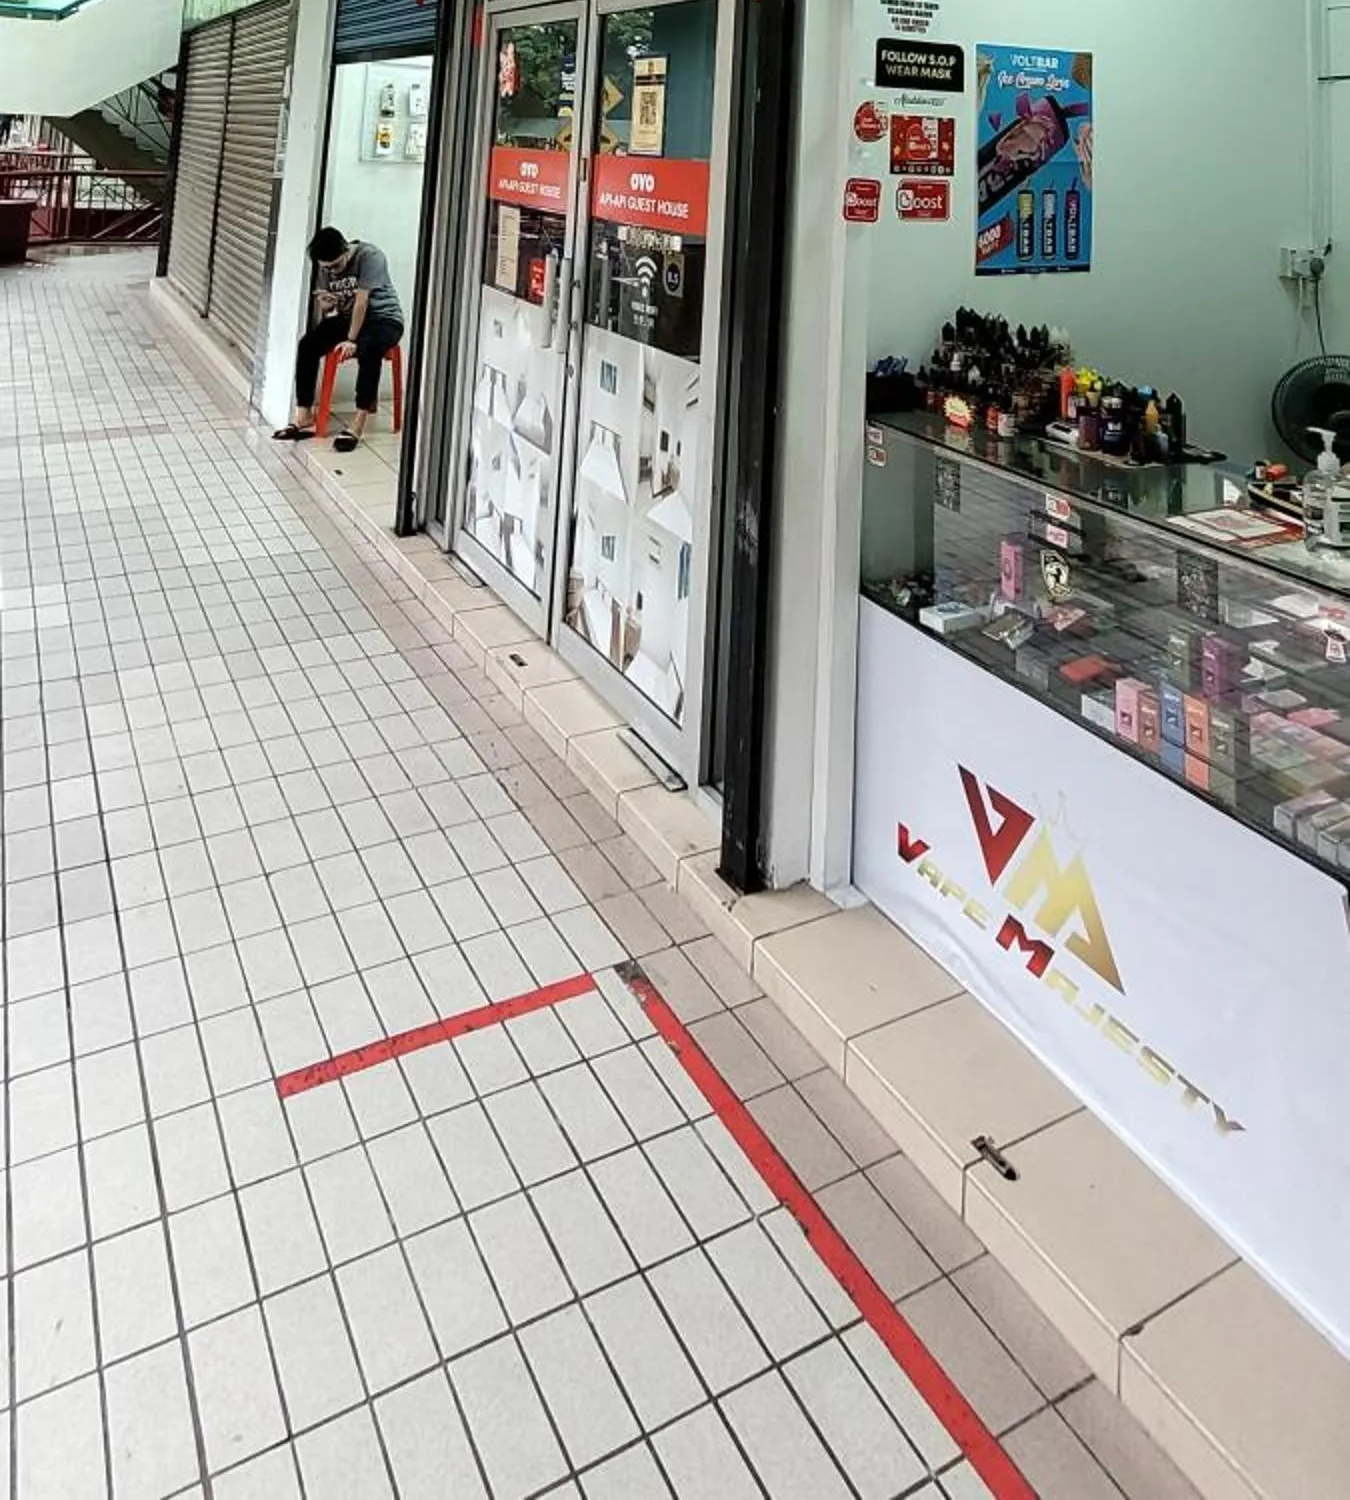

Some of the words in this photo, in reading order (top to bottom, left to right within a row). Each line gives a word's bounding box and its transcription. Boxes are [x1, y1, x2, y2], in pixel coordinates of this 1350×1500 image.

[881, 49, 926, 65] FOLLOW
[885, 64, 919, 77] WEAR
[920, 67, 953, 80] MASK
[630, 173, 655, 193] OYO
[627, 196, 656, 213] GUEST
[657, 201, 689, 219] HOUSE
[897, 821, 991, 931] VAPE
